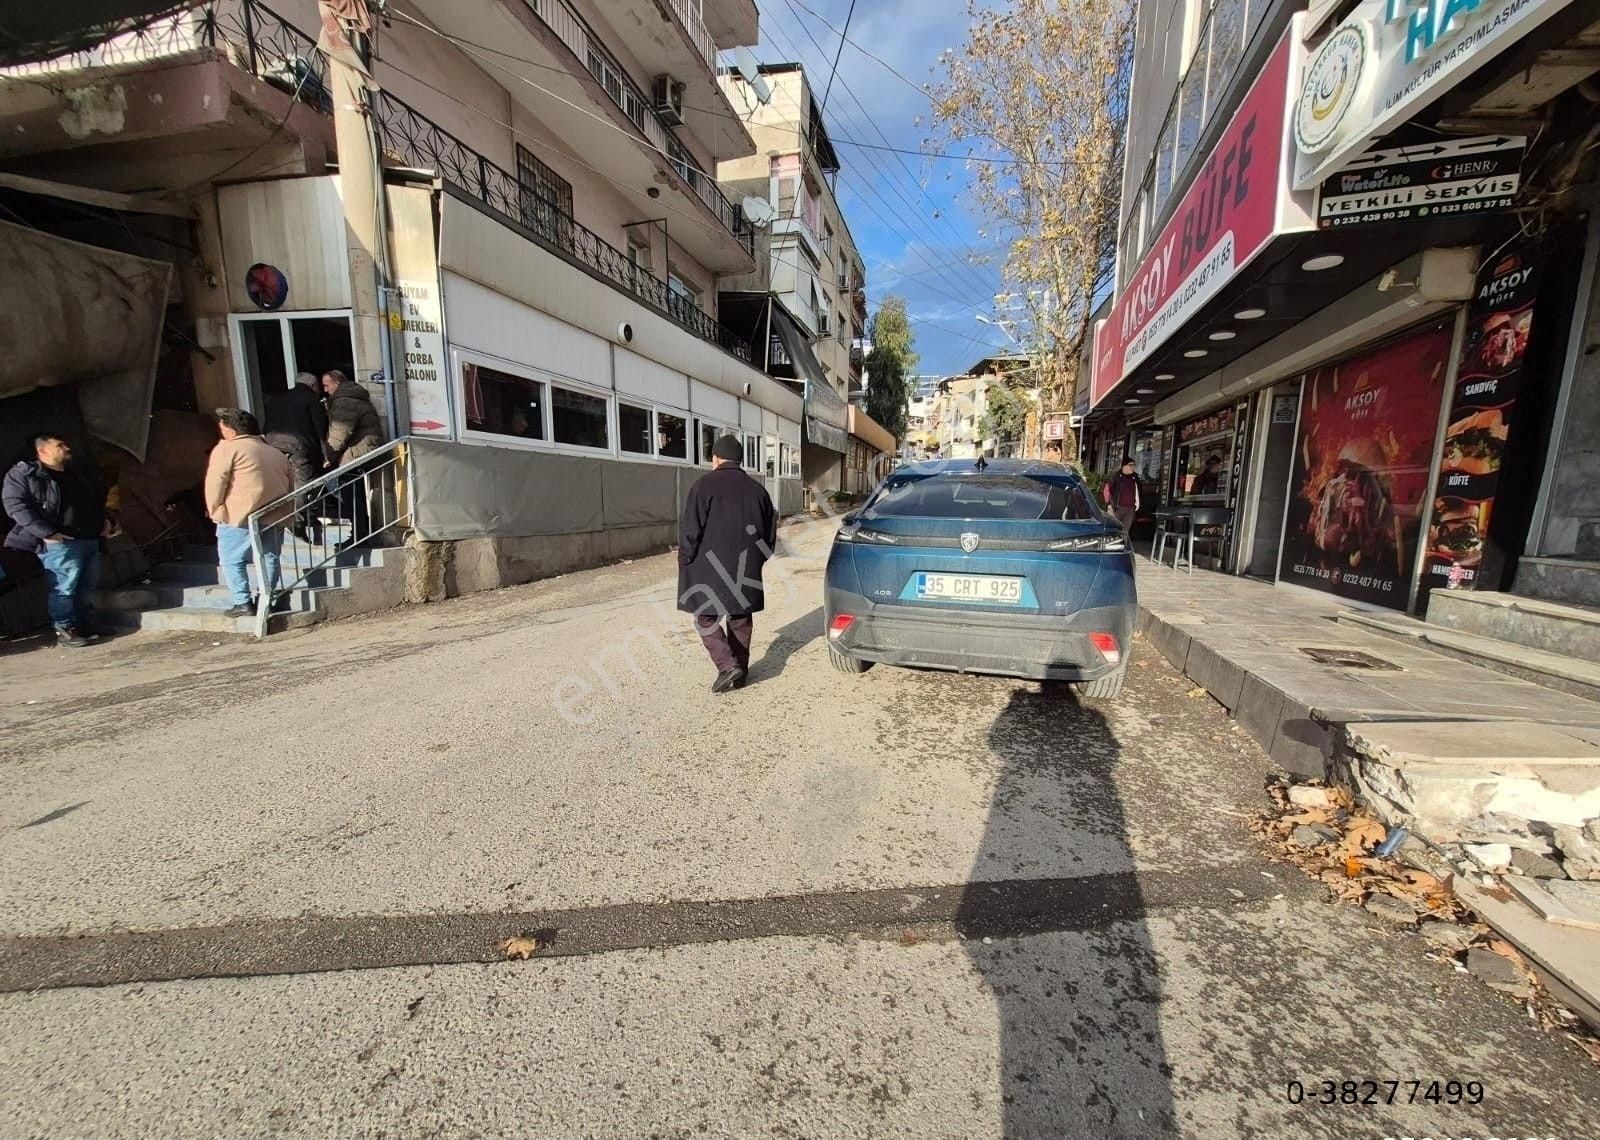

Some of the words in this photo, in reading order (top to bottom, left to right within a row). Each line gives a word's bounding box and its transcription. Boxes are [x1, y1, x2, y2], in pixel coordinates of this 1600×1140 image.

[1404, 60, 1441, 96] KÜLTÜR
[1326, 190, 1413, 213] YETKİLİ
[1424, 180, 1514, 200] SERVİS
[1120, 232, 1176, 347] AKSOY
[1180, 111, 1257, 274] BÜFE
[1221, 241, 1231, 266] 65
[1478, 267, 1533, 299] AKSOY
[410, 304, 419, 315] EV
[415, 337, 422, 348] &
[405, 353, 433, 367] ÇORBA
[405, 368, 436, 381] SALONU
[1344, 388, 1380, 410] AKSOY
[1233, 420, 1245, 490] AKSOY
[1448, 473, 1470, 486] KÖFTE
[927, 577, 944, 592] 35
[954, 579, 981, 595] CRT
[990, 581, 1018, 597] 925
[1342, 573, 1358, 585] 0232
[1359, 576, 1372, 588] 487
[1372, 579, 1382, 589] 91
[1382, 581, 1393, 592] 65
